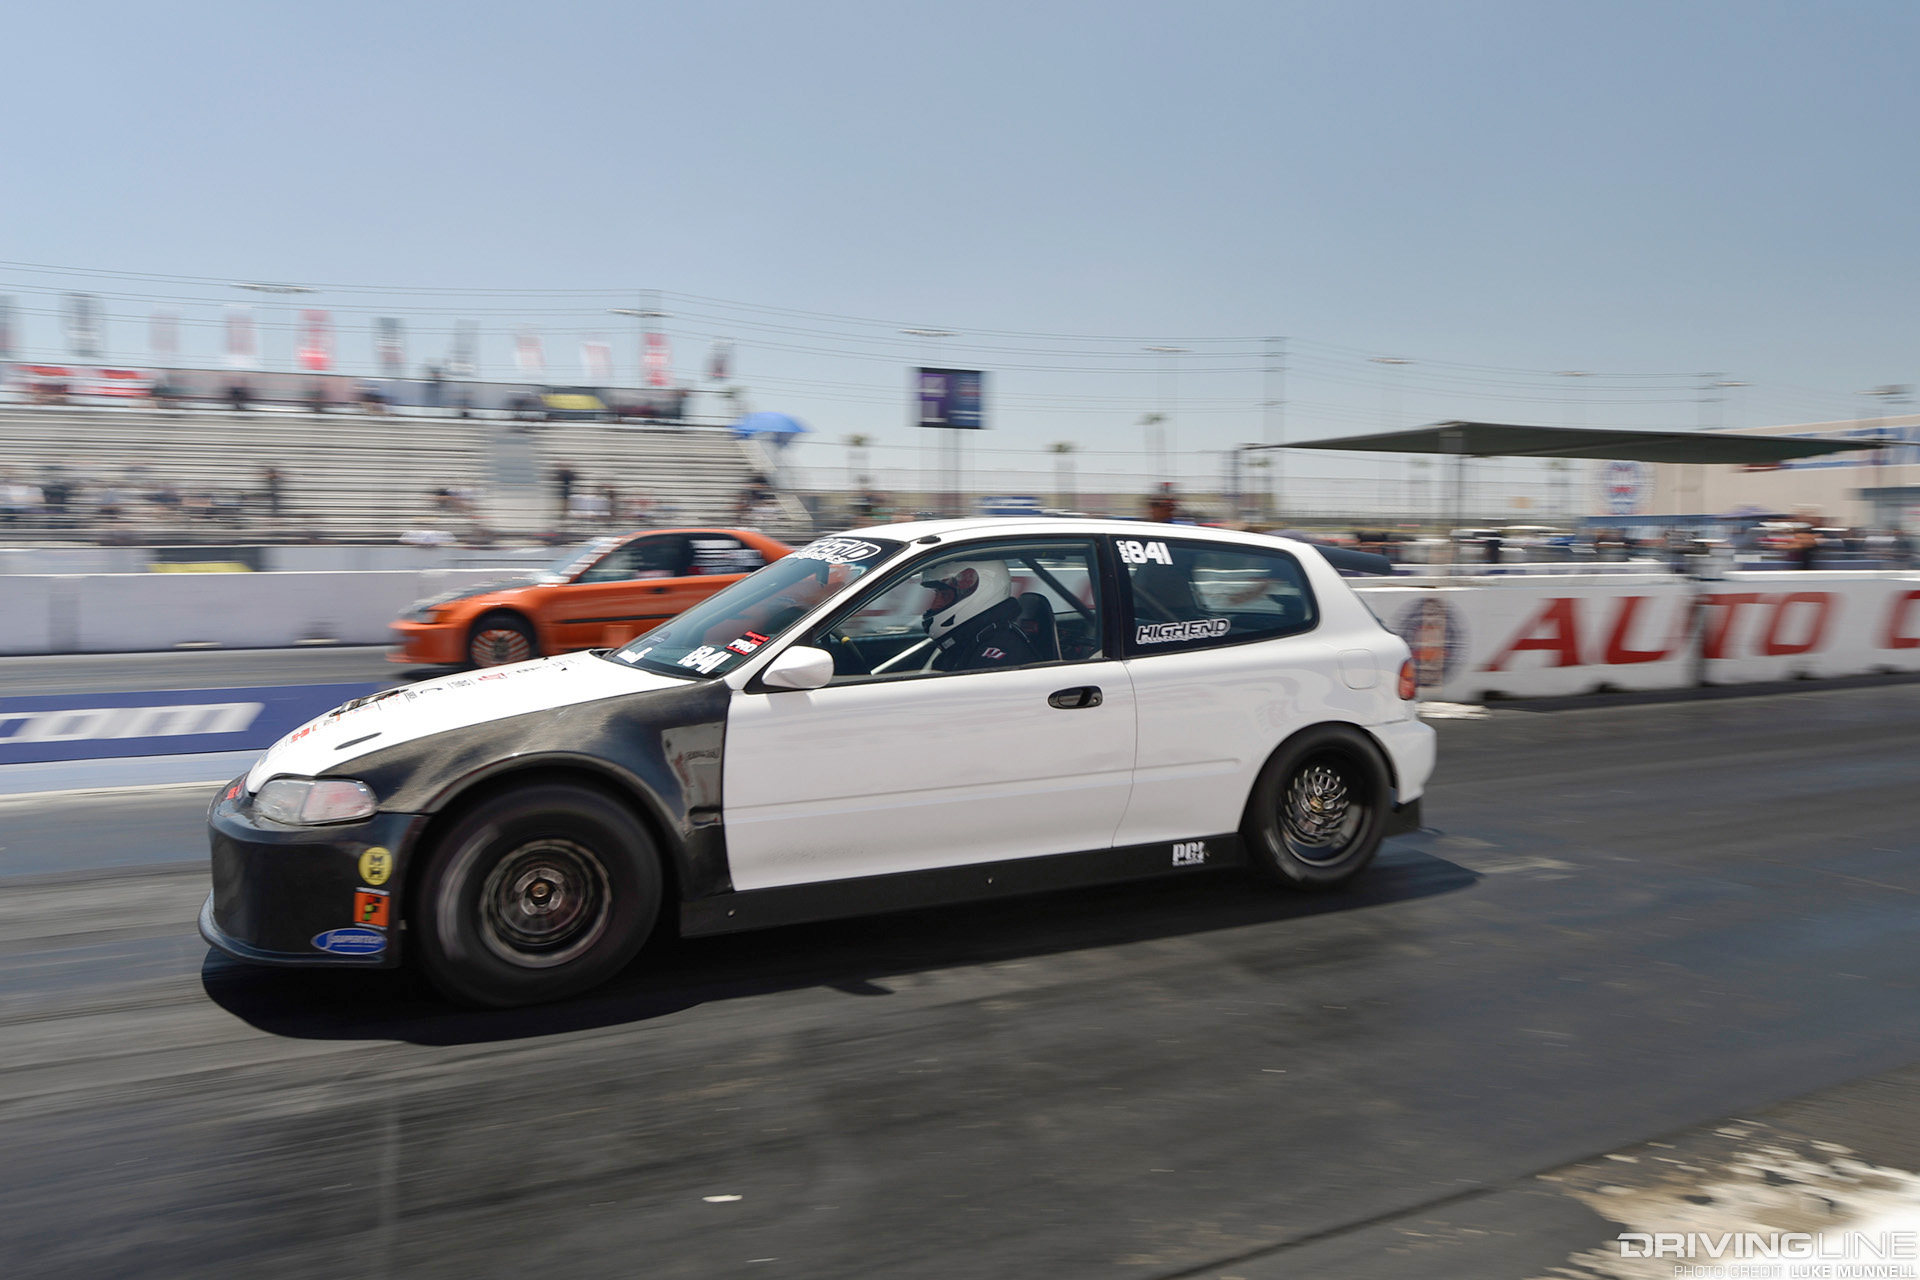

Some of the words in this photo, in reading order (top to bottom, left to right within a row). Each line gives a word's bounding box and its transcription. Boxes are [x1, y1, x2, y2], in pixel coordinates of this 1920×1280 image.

[1125, 540, 1174, 565] 841
[1136, 618, 1231, 644] HIGHEND
[1478, 592, 1842, 672] AUTO
[683, 646, 733, 674] 841
